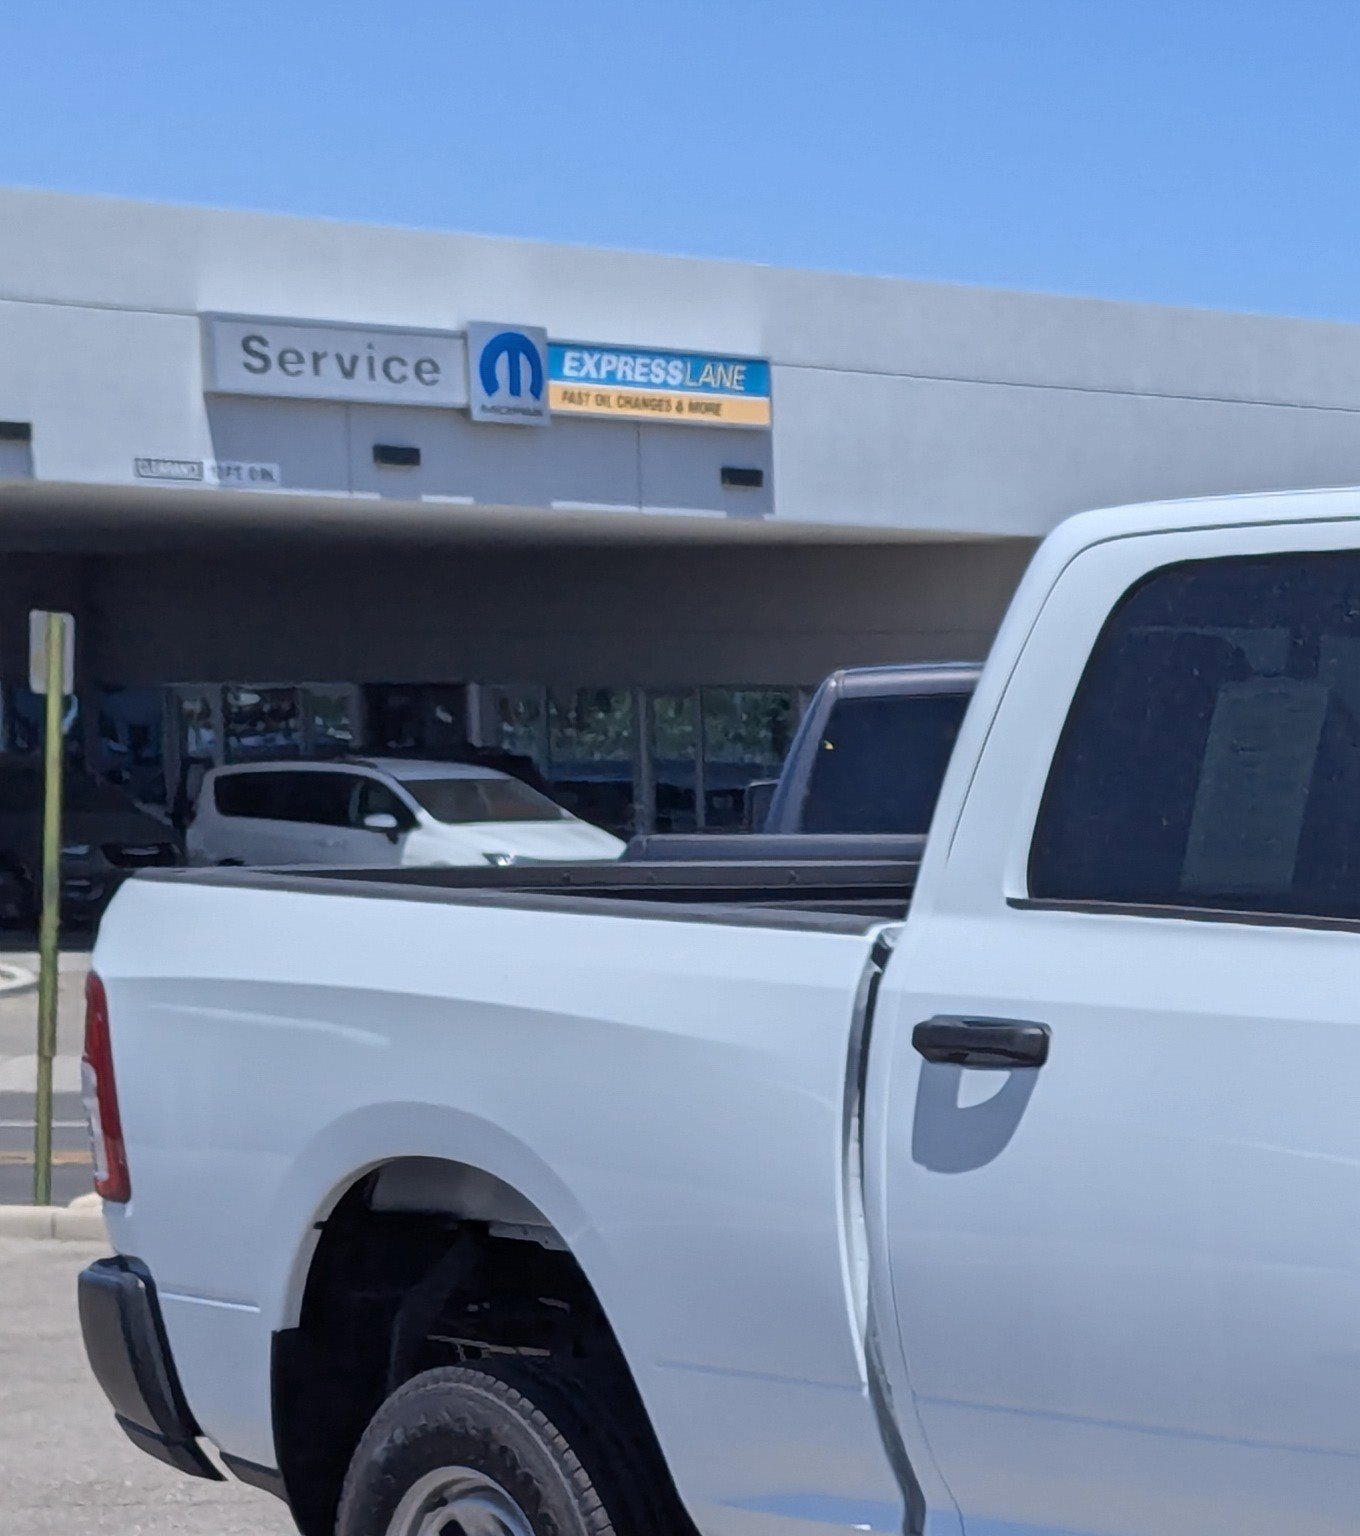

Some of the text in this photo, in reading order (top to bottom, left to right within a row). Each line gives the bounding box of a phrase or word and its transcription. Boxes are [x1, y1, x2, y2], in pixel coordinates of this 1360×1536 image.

[241, 334, 441, 387] Service
[561, 389, 590, 406] FAST
[595, 393, 612, 408] OIL
[616, 394, 672, 413] CHANGES
[688, 400, 723, 417] MORE
